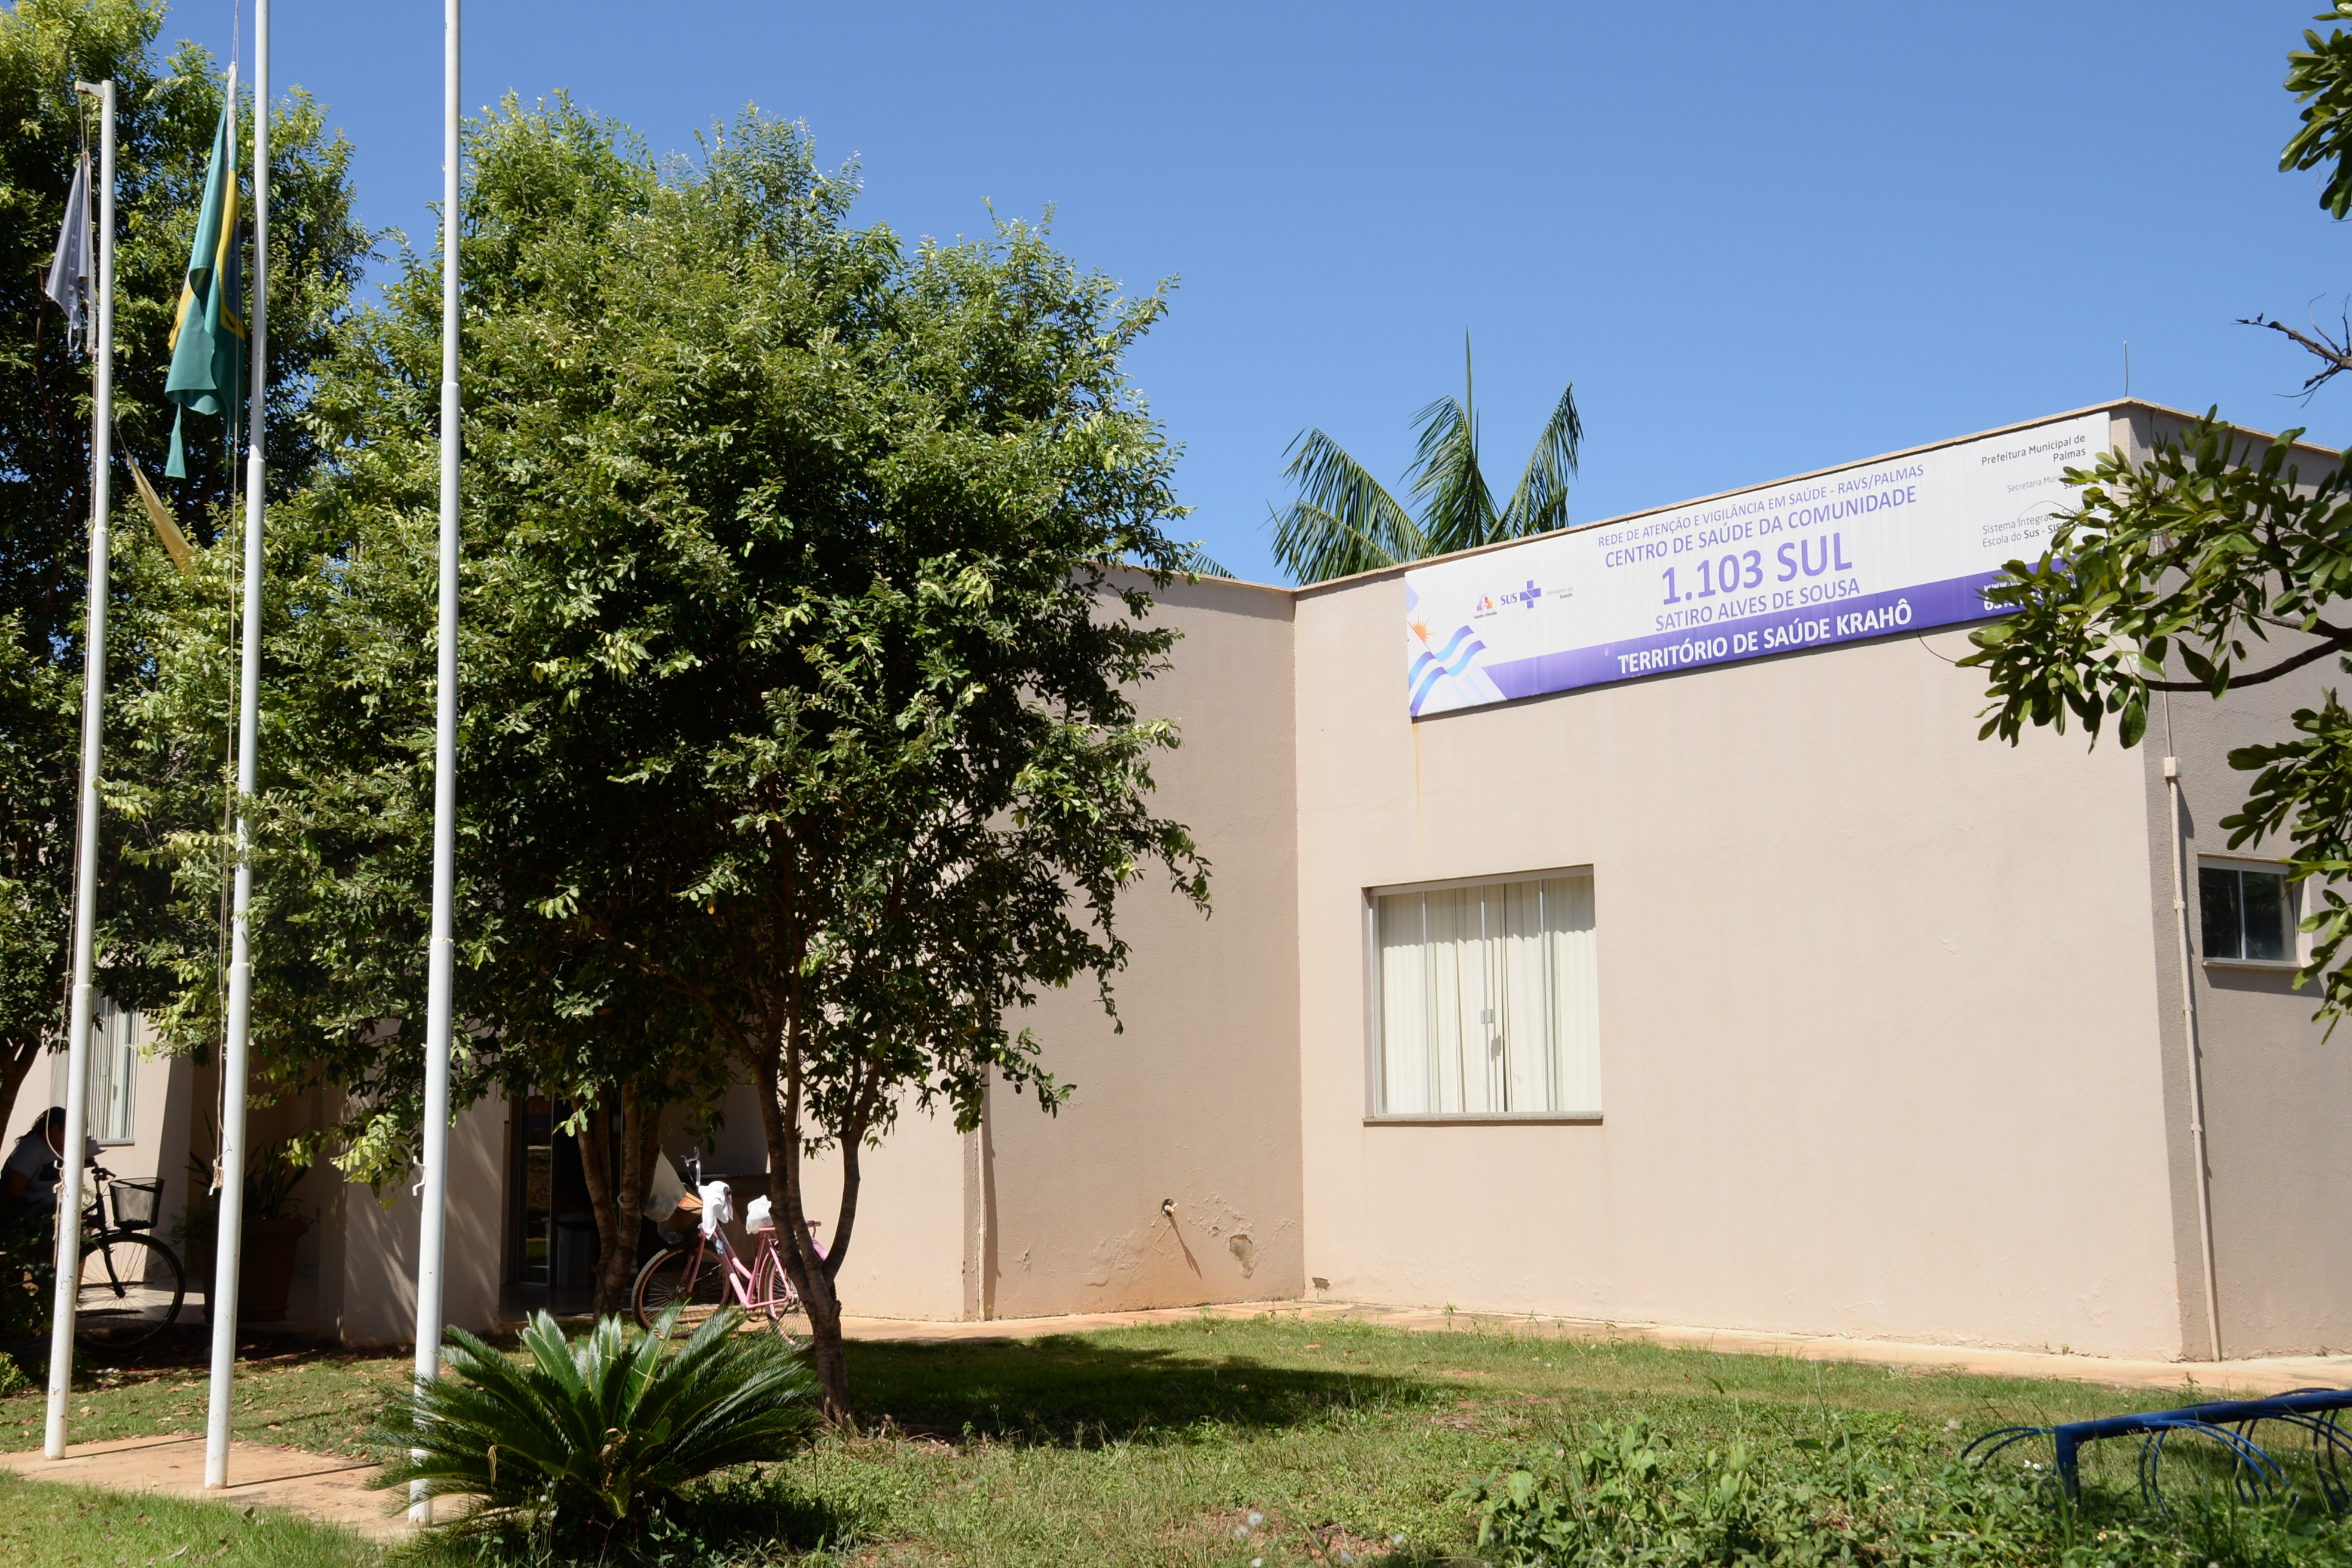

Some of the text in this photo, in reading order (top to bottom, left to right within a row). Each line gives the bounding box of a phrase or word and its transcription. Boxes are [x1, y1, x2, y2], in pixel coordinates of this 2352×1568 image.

[1982, 435, 2085, 466] Prefeitura Municipal de
[2053, 448, 2086, 462] Palmas
[2007, 479, 2042, 492] Secretaria
[1598, 532, 1623, 547] REDE
[1627, 529, 1639, 541] DE
[1643, 517, 1690, 538] ATENÇÃO
[1695, 516, 1699, 526] E
[1703, 501, 1765, 523] VIGILÂNCIA
[1769, 496, 1786, 509] EM
[1789, 488, 1827, 505] SAÚDE
[1838, 464, 1924, 494] RAVS/PALMAS
[1606, 485, 1916, 568] CENTRO DE SAÚDE DA COMUNIDADE
[1983, 521, 2016, 534] Sistema
[1983, 535, 2009, 547] Escola
[2011, 532, 2022, 542] do
[2023, 529, 2039, 539] Sus
[1662, 532, 1852, 605] 1.103 SUL
[1500, 593, 1517, 605] SUS
[1655, 578, 1860, 631] SATIRO ALVES DE SOUSA
[1618, 598, 1912, 673] TERRITÓRIO DE SAÚDE KRAHÔ
